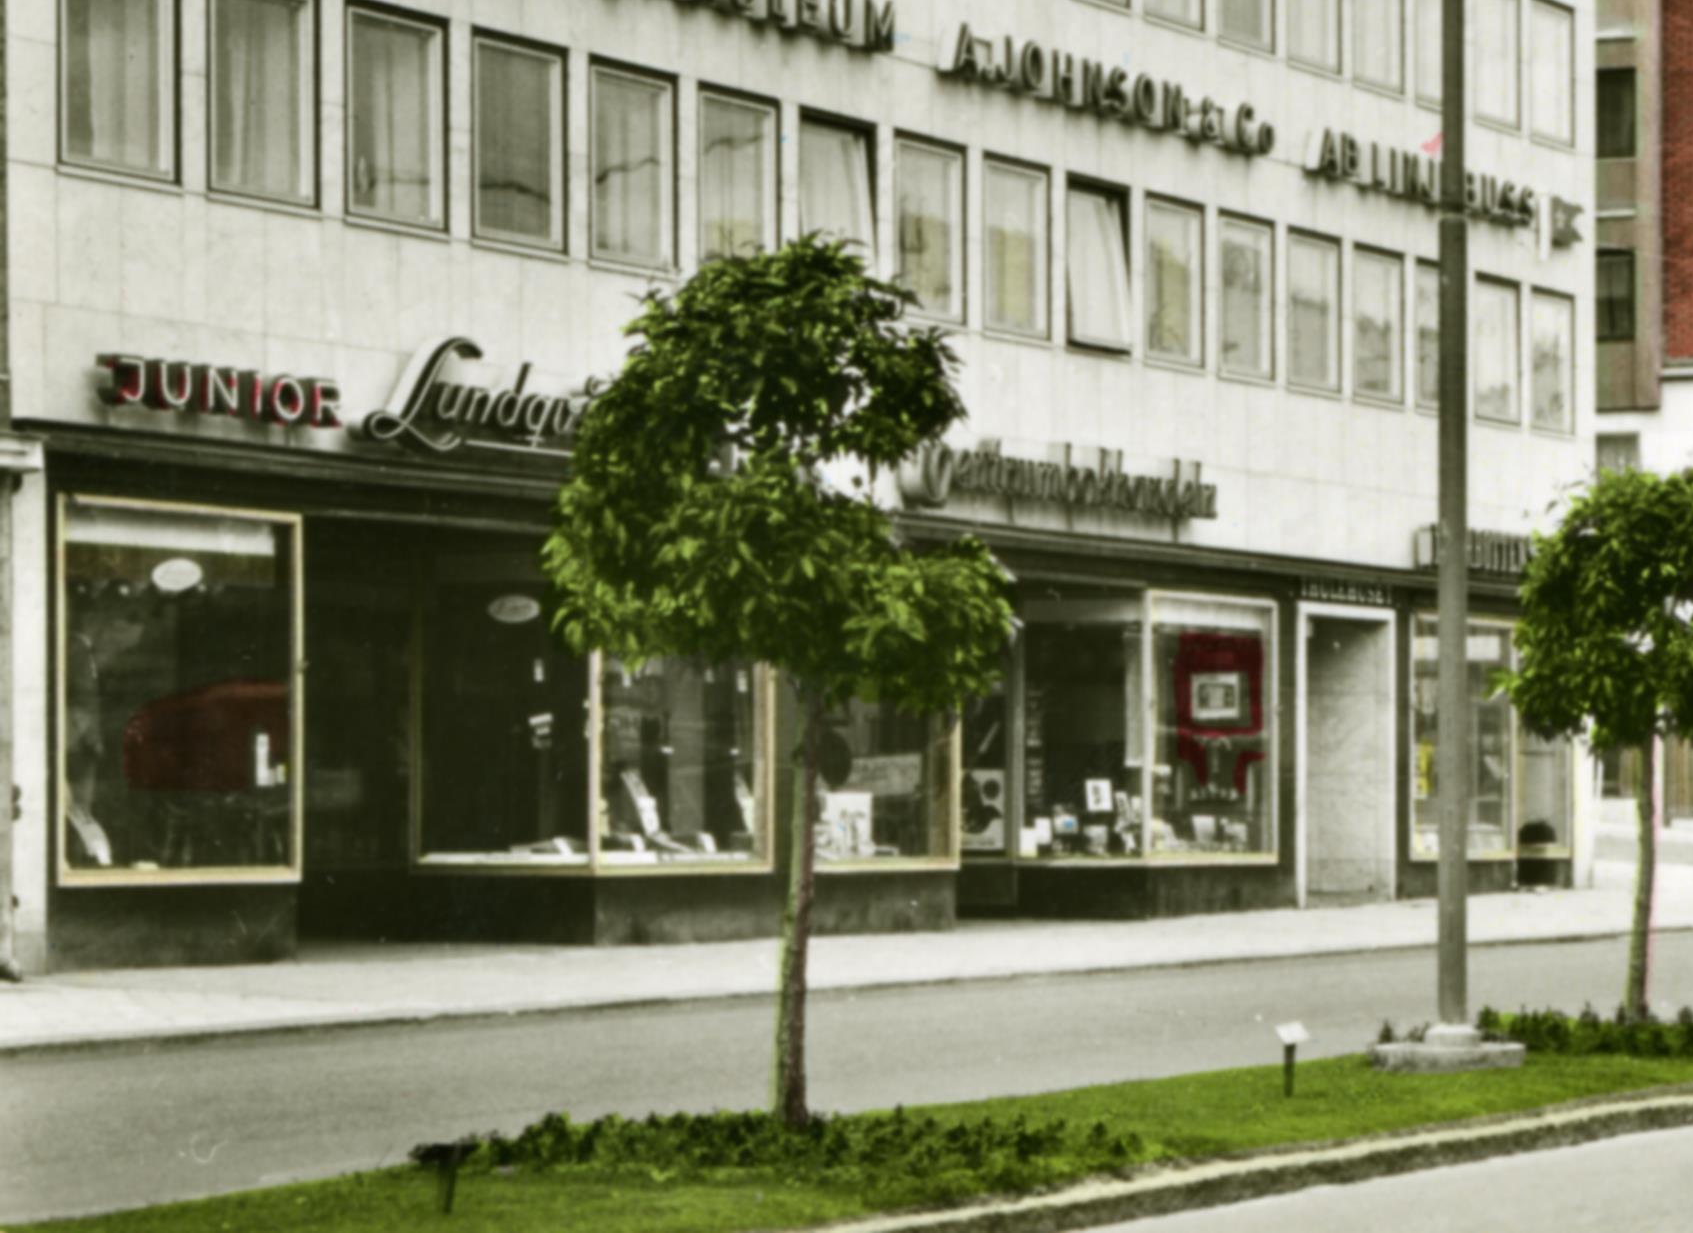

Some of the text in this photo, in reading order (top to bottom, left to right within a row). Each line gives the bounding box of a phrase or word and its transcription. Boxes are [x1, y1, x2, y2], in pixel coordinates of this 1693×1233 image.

[1304, 127, 1534, 223] AB LINJBUSS
[97, 354, 341, 428] JUNIOR
